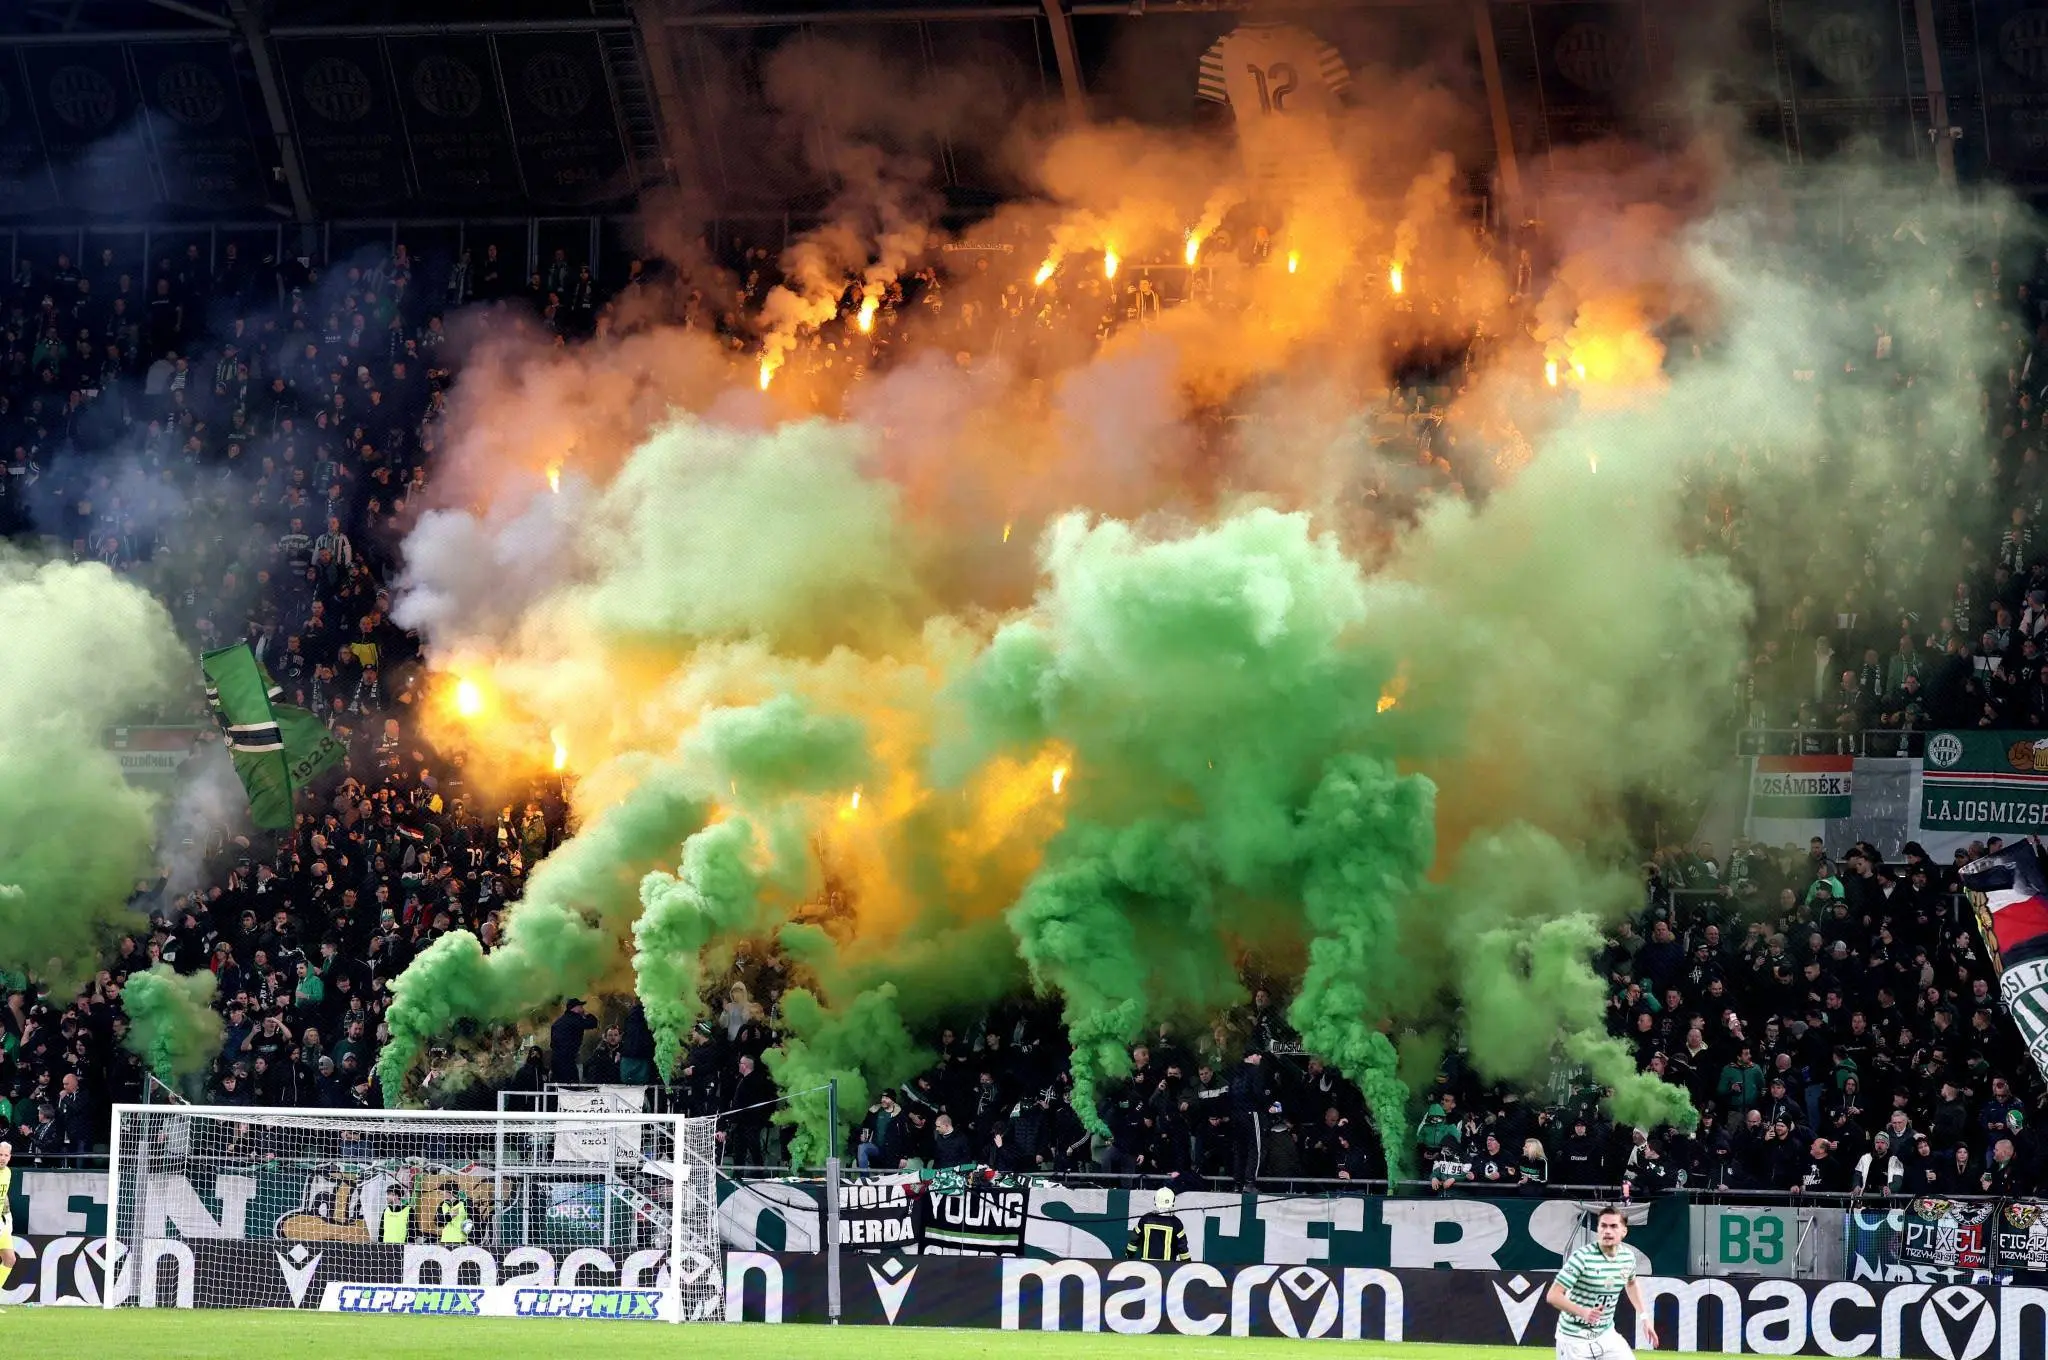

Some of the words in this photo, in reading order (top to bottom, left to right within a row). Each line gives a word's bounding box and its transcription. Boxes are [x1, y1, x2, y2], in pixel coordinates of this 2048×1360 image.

[1247, 62, 1298, 114] 12
[291, 736, 334, 780] 1928
[1763, 774, 1841, 795] ZSÁMBÉK
[1451, 1164, 1462, 1174] 99
[929, 1191, 1024, 1228] YOUNG
[1719, 1214, 1784, 1265] B3
[1906, 1222, 1986, 1254] PIXEL
[2000, 1233, 2048, 1251] FIGAR
[1001, 1258, 1404, 1342] macron
[1635, 1275, 2048, 1360] macron
